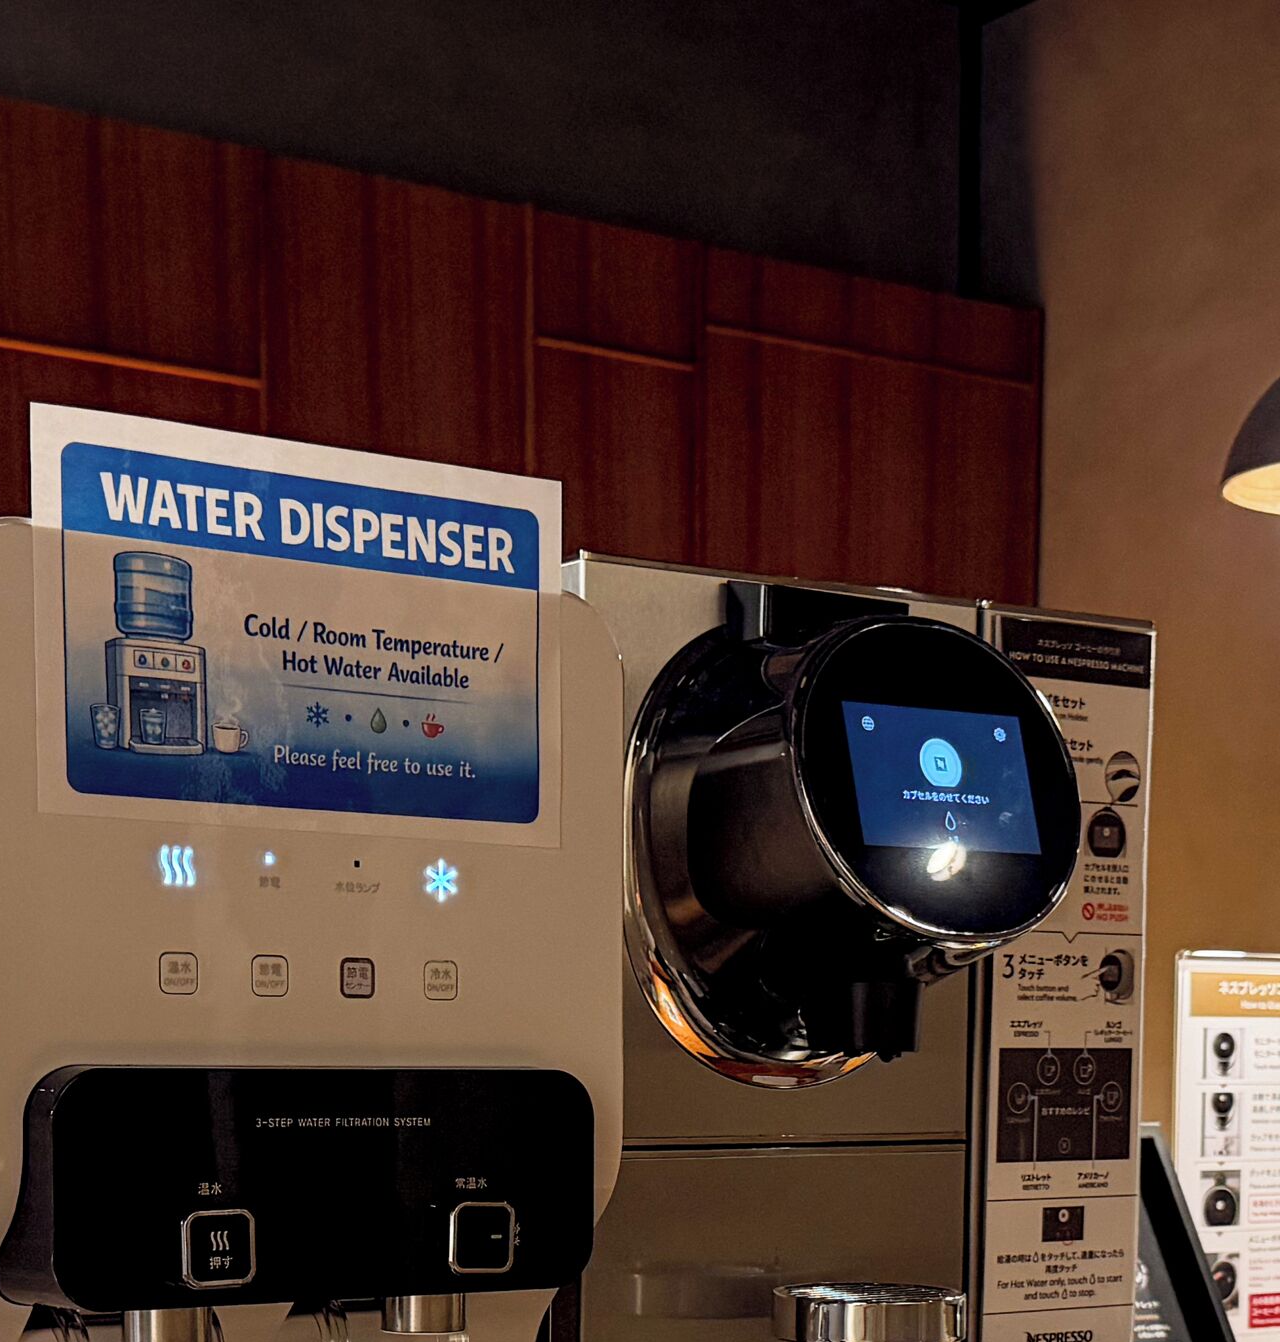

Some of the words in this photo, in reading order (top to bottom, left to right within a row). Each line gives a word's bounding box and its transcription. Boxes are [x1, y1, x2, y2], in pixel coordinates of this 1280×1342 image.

[99, 471, 266, 541] WATER
[280, 499, 515, 574] DISPENSER
[244, 613, 290, 642] Cold
[298, 620, 307, 642] /
[312, 622, 367, 649] Room
[372, 629, 490, 663] Temperature
[493, 643, 505, 664] /
[281, 651, 317, 675] Hot
[323, 655, 382, 681] Water
[387, 663, 469, 689] Available
[1008, 650, 1030, 661] HOW
[1032, 653, 1044, 663] TO
[1045, 655, 1061, 666] USE
[1067, 658, 1110, 671] NESPRESSO
[1111, 663, 1145, 676] MACHINE
[273, 745, 327, 768] Please
[331, 749, 362, 773] feel
[367, 752, 398, 775] free
[403, 757, 421, 775] to
[426, 761, 453, 777] use
[458, 760, 476, 779] it.
[902, 789, 990, 805] カプセルをのせてください
[346, 967, 370, 980] 節電
[1002, 954, 1015, 979] 3
[1018, 954, 1089, 967] メニューボタンを
[430, 967, 452, 981] 冷水
[1018, 968, 1044, 981] タッチ
[163, 977, 196, 987] ON/OFF
[255, 979, 285, 989] ON/OFF
[426, 982, 455, 993] ON/OFF
[255, 1117, 294, 1128] 3-STEP
[298, 1117, 331, 1128] WATER
[335, 1117, 389, 1127] FILTRATION
[394, 1117, 431, 1127] SYSTEM
[198, 1182, 223, 1195] 温水
[455, 1177, 488, 1190] 常温水
[209, 1255, 233, 1270] 押す
[1026, 1278, 1048, 1288] Water
[1067, 1275, 1088, 1286] touch
[1097, 1275, 1106, 1283] to
[1107, 1274, 1123, 1283] start
[1024, 1291, 1038, 1301] and
[1039, 1290, 1059, 1300] touch
[1069, 1289, 1077, 1297] to
